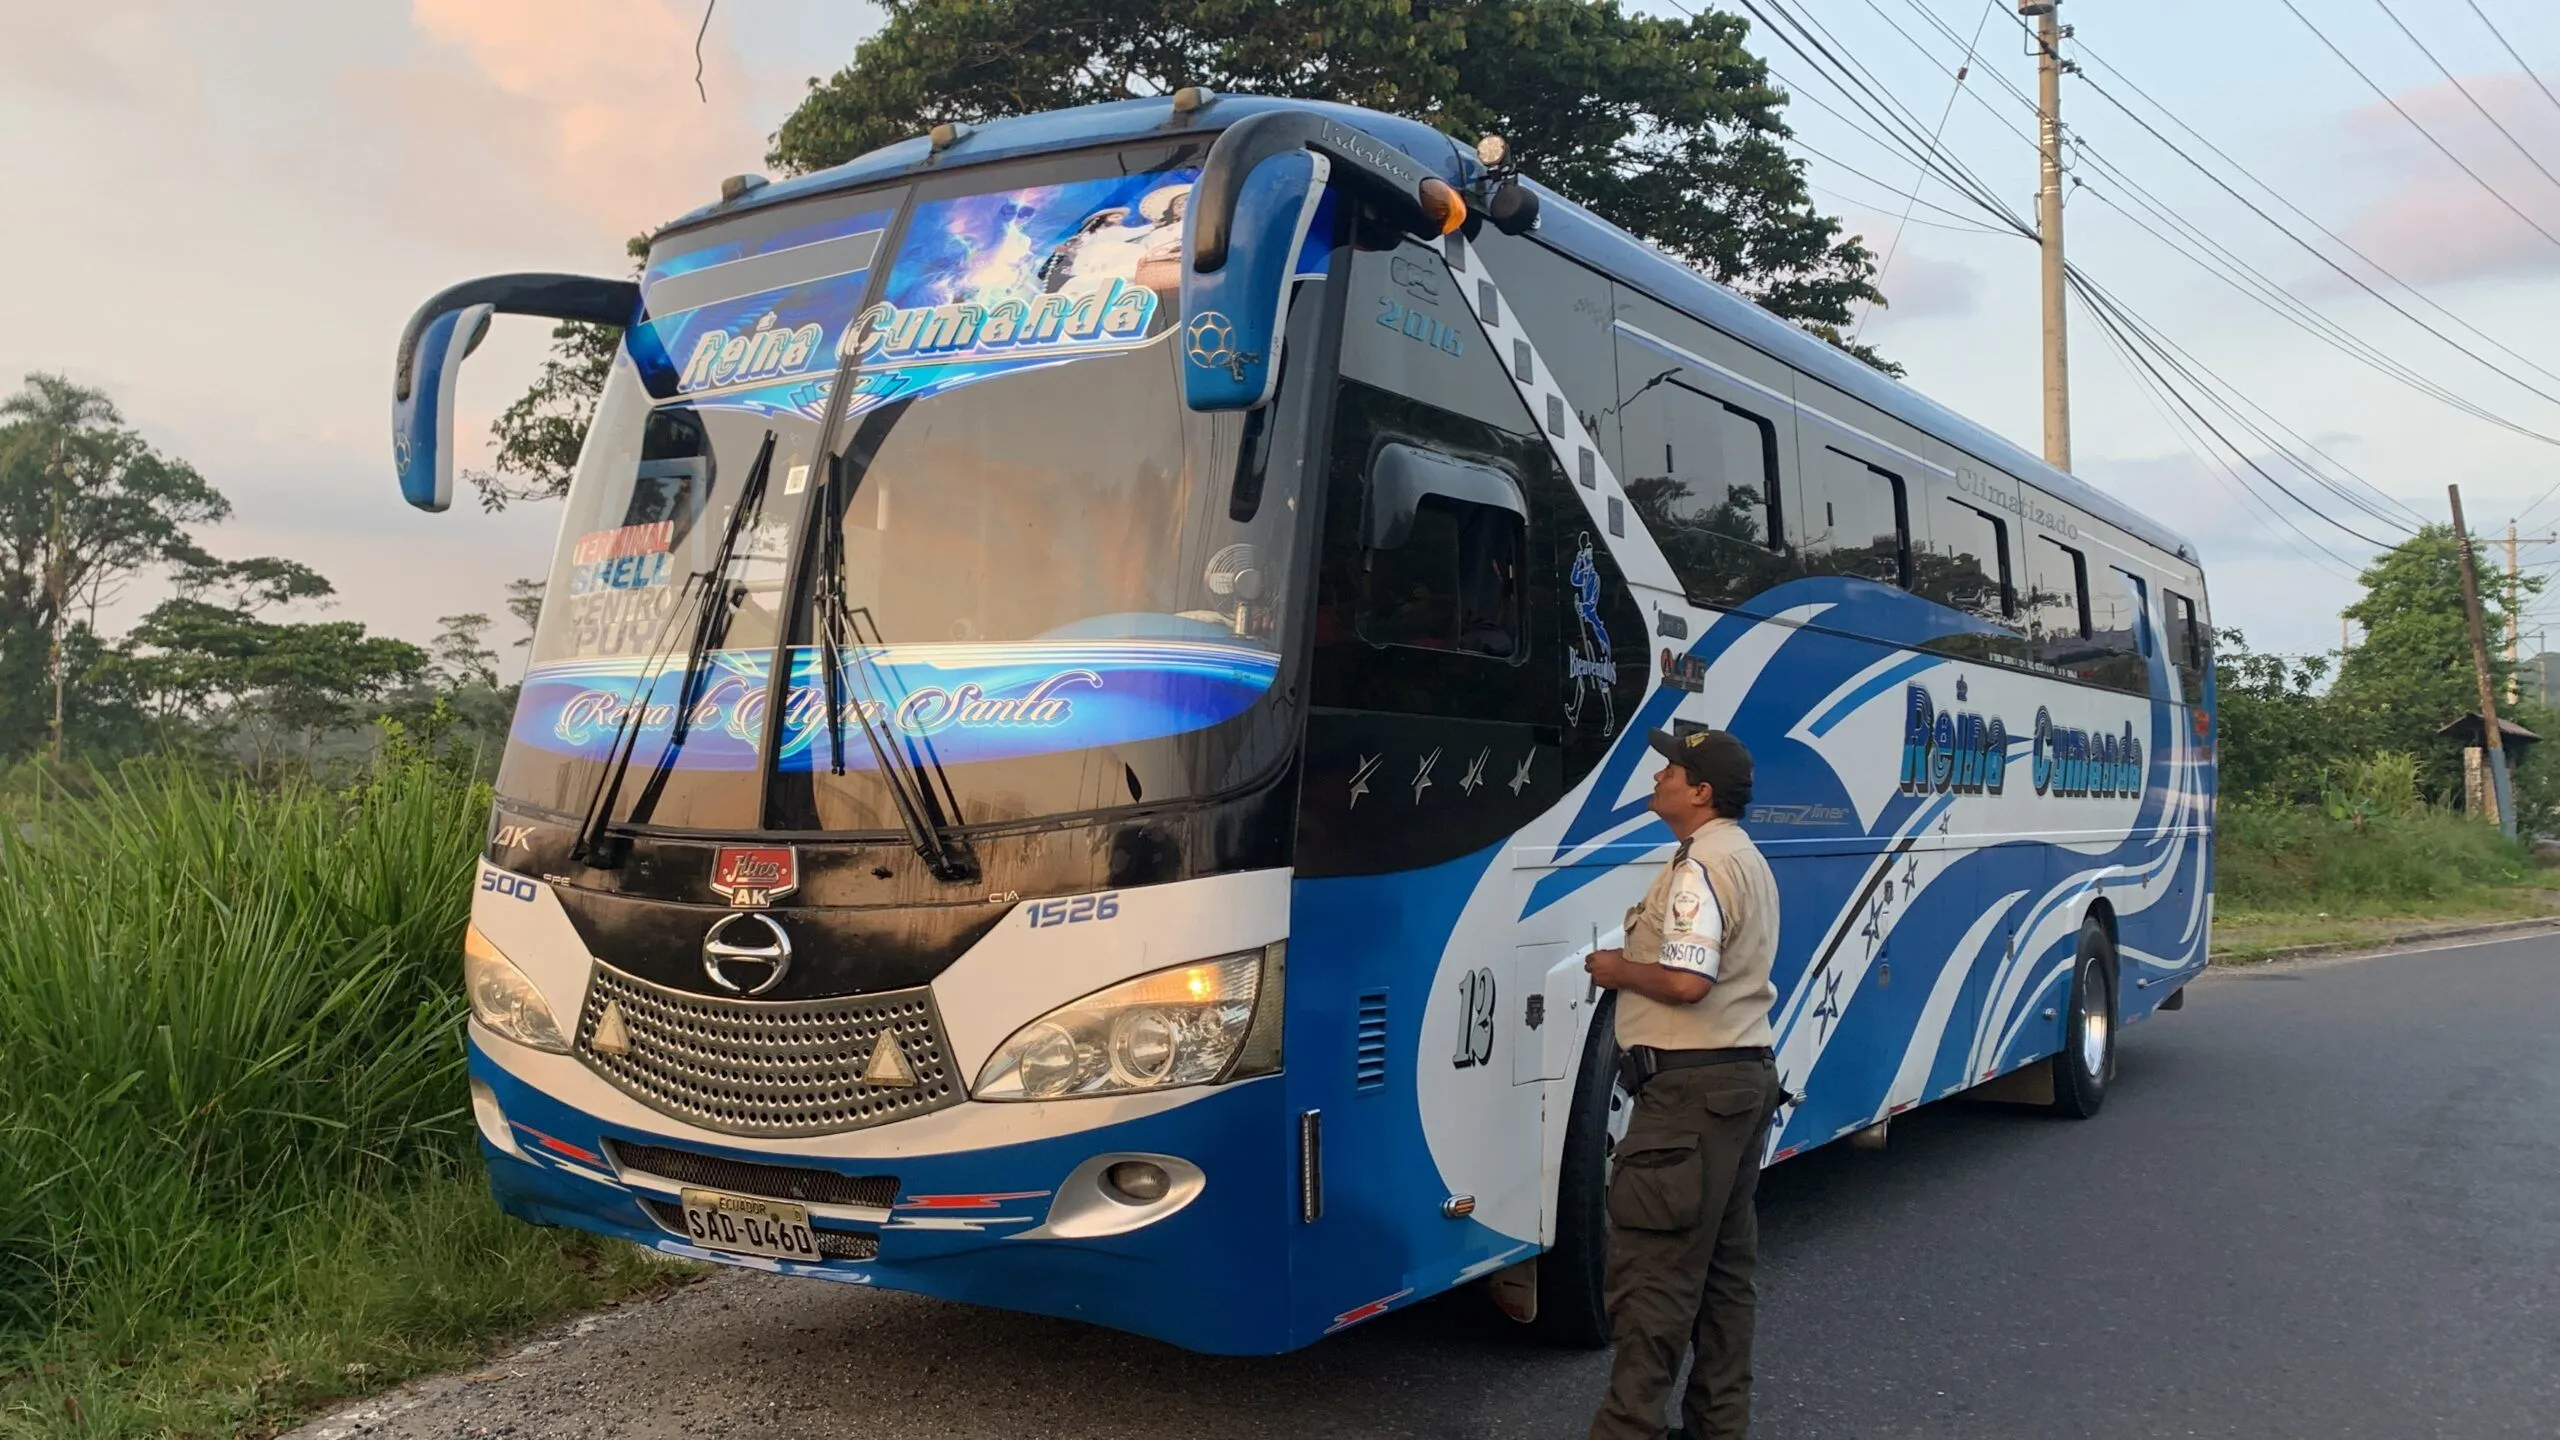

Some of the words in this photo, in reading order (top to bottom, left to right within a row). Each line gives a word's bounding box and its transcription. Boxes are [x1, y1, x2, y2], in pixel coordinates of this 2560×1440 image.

[676, 310, 824, 393] Reina
[836, 277, 1159, 361] Cumanda
[1375, 296, 1464, 358] 2016
[1955, 465, 2080, 541] Climatizado
[573, 519, 674, 567] TERMINAL
[570, 550, 675, 597] SHELL
[1568, 645, 1617, 686] Bienvenidos
[553, 688, 677, 746] Reina
[726, 683, 890, 760] Aga
[893, 668, 1104, 737] Santa
[1900, 675, 2008, 798] Reina
[2032, 704, 2143, 799] Cumanda
[492, 825, 537, 852] AK
[481, 869, 537, 903] 500
[725, 851, 780, 883] Hino
[734, 888, 768, 905] AK
[988, 890, 1020, 903] CIA
[1026, 893, 1119, 929] 1526
[719, 1197, 768, 1216] ECUADOR
[688, 1209, 813, 1255] SAD-0460
